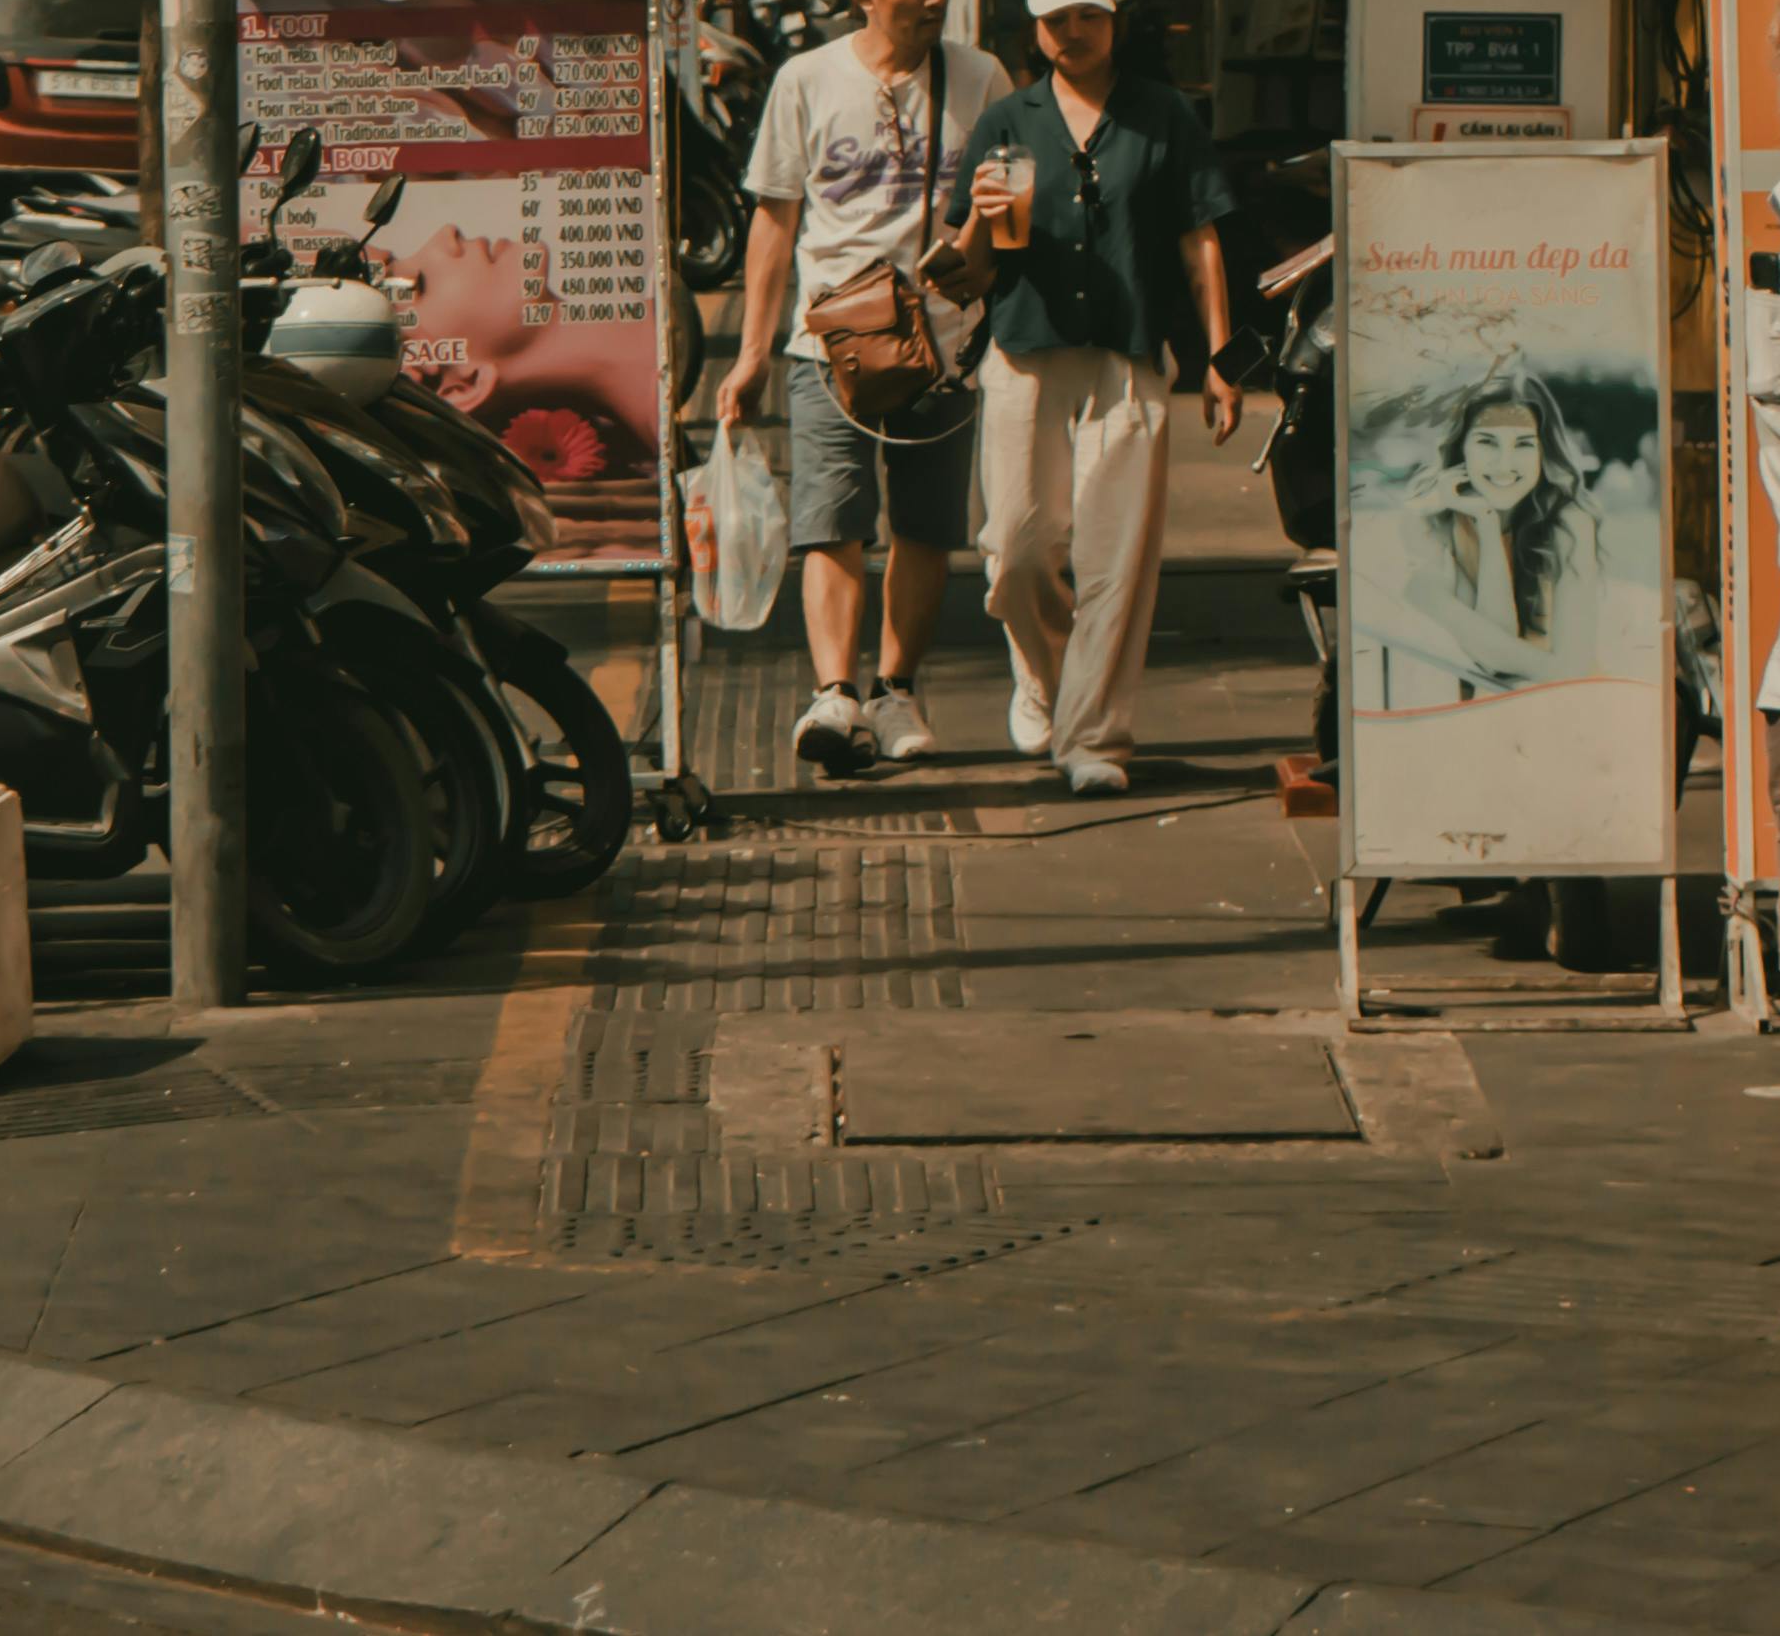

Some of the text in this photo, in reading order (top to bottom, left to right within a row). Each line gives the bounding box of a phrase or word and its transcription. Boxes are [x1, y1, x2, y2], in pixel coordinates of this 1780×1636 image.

[267, 15, 328, 39] FOOT
[325, 96, 351, 115] with
[356, 96, 376, 114] hot
[381, 97, 415, 114] stone
[333, 147, 398, 171] BODY
[558, 172, 611, 191] 200.000
[287, 198, 611, 228] body 300.000
[559, 224, 613, 243] 400.000
[560, 250, 613, 269] 350.000
[1450, 245, 1519, 276] mụn
[1526, 240, 1581, 279] đẹp
[1588, 240, 1630, 270] da
[561, 303, 615, 323] 700.000
